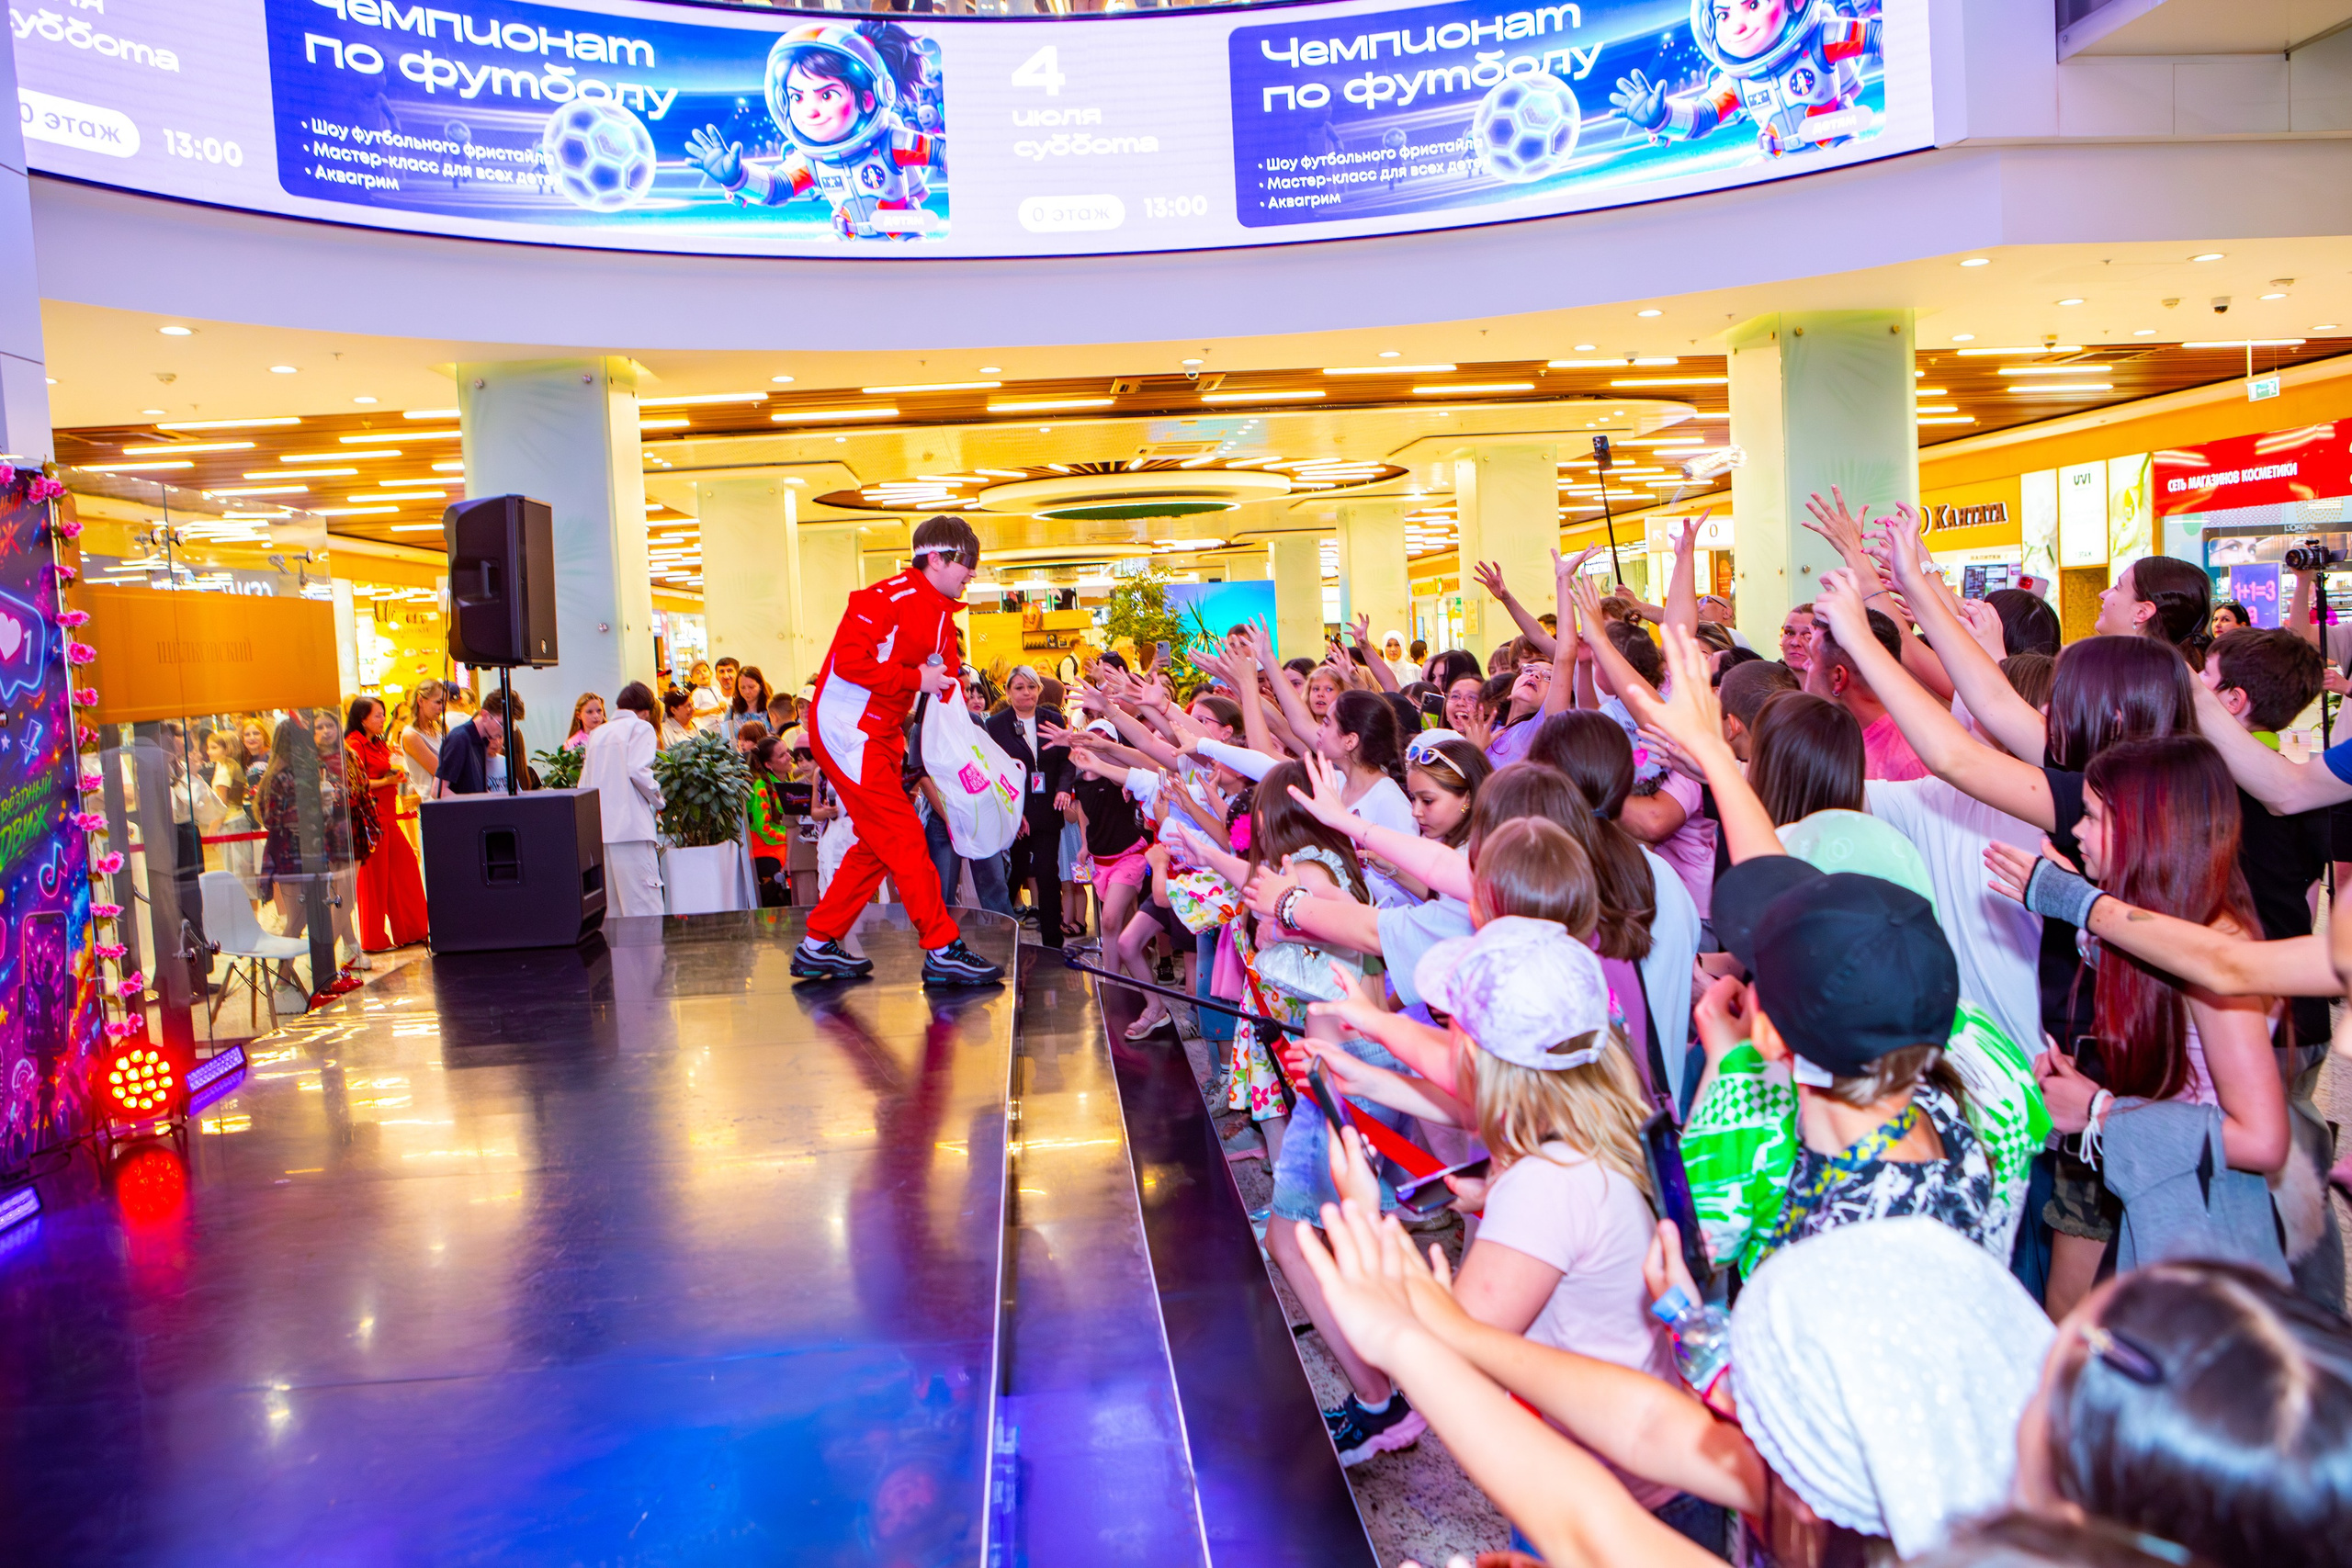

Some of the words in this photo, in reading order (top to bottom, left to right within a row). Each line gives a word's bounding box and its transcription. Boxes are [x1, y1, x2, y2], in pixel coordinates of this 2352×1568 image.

[9, 7, 180, 73] уббота
[304, 32, 385, 75] по
[399, 49, 679, 121] футболу
[1012, 45, 1066, 96] 4
[1262, 83, 1331, 112] по
[1343, 41, 1605, 110] футболу
[44, 112, 122, 144] этаж
[1012, 107, 1102, 127] июля
[163, 128, 243, 168] 13:00
[311, 117, 349, 142] Шоу
[351, 125, 461, 156] футбольного
[462, 141, 555, 166] фристайла
[1013, 132, 1159, 162] суббота
[1266, 157, 1298, 172] Шоу
[1300, 148, 1396, 171] футбольного
[1398, 137, 1484, 161] фристайла
[313, 140, 440, 175] Мастер-класс
[441, 163, 473, 179] для
[475, 166, 514, 184] всех
[314, 164, 401, 191] Аквагрим
[1267, 169, 1378, 190] Мастер-класс
[1379, 165, 1408, 183] для
[1410, 161, 1445, 177] всех
[1032, 207, 1045, 222] 0
[1052, 206, 1111, 222] этаж
[1143, 194, 1208, 219] 13:00
[1268, 191, 1342, 209] Аквагрим
[2167, 478, 2187, 492] СЕТЬ
[2188, 469, 2240, 490] МАГАЗИНОВ
[2241, 462, 2298, 483] КОСМЕТИКИ
[2233, 580, 2276, 602] 1+1=3
